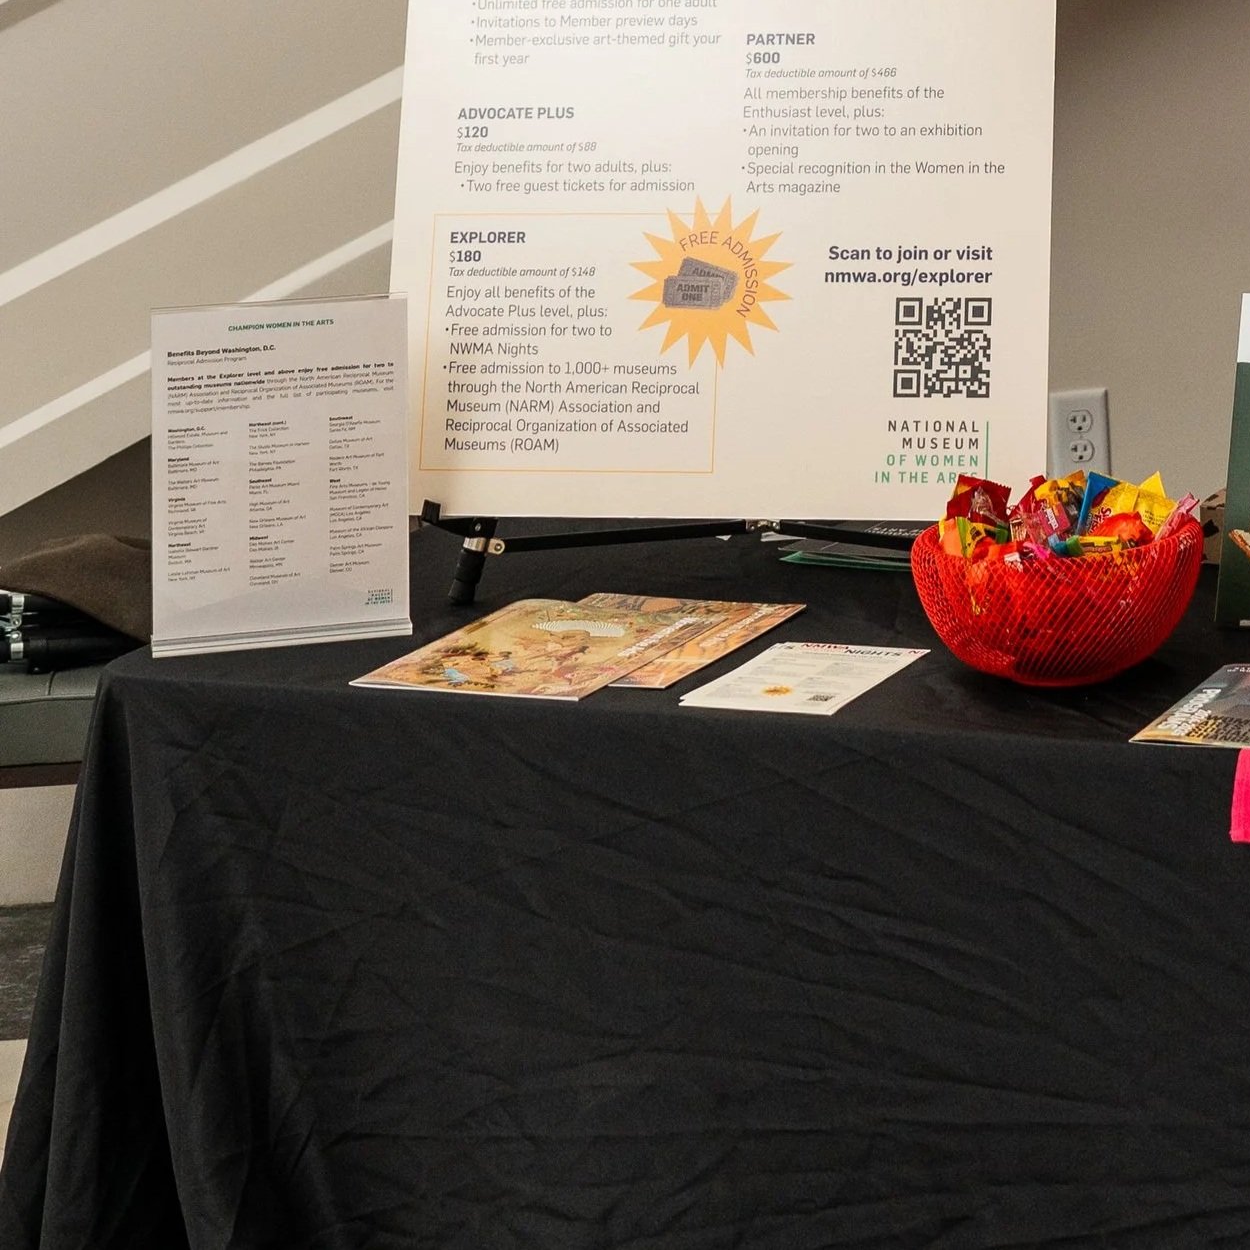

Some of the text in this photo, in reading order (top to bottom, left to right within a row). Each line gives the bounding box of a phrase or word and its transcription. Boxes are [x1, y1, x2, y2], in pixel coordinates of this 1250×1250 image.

[746, 32, 815, 45] PARTNER
[745, 51, 780, 65] $600
[457, 106, 574, 120] ADVOCATE PLUS
[456, 125, 488, 139] $120
[450, 231, 526, 244] EXPLORER
[449, 249, 481, 263] $180
[828, 245, 993, 264] Scan to join or visit
[678, 230, 760, 319] FREE ADMISSION
[824, 268, 993, 287] nmwa.org/explorer
[227, 323, 264, 332] CHAMPION
[265, 321, 292, 329] WOMEN
[315, 318, 334, 326] ARTS
[167, 350, 195, 358] Benefits
[195, 348, 221, 356] Beyond
[221, 346, 262, 354] Washington,
[448, 360, 677, 375] Free admission to 1,000+ museums
[887, 419, 979, 433] NATIONAL
[902, 437, 978, 450] MUSEUM
[886, 453, 978, 467] OF WOMEN
[874, 470, 979, 484] IN THE AR
